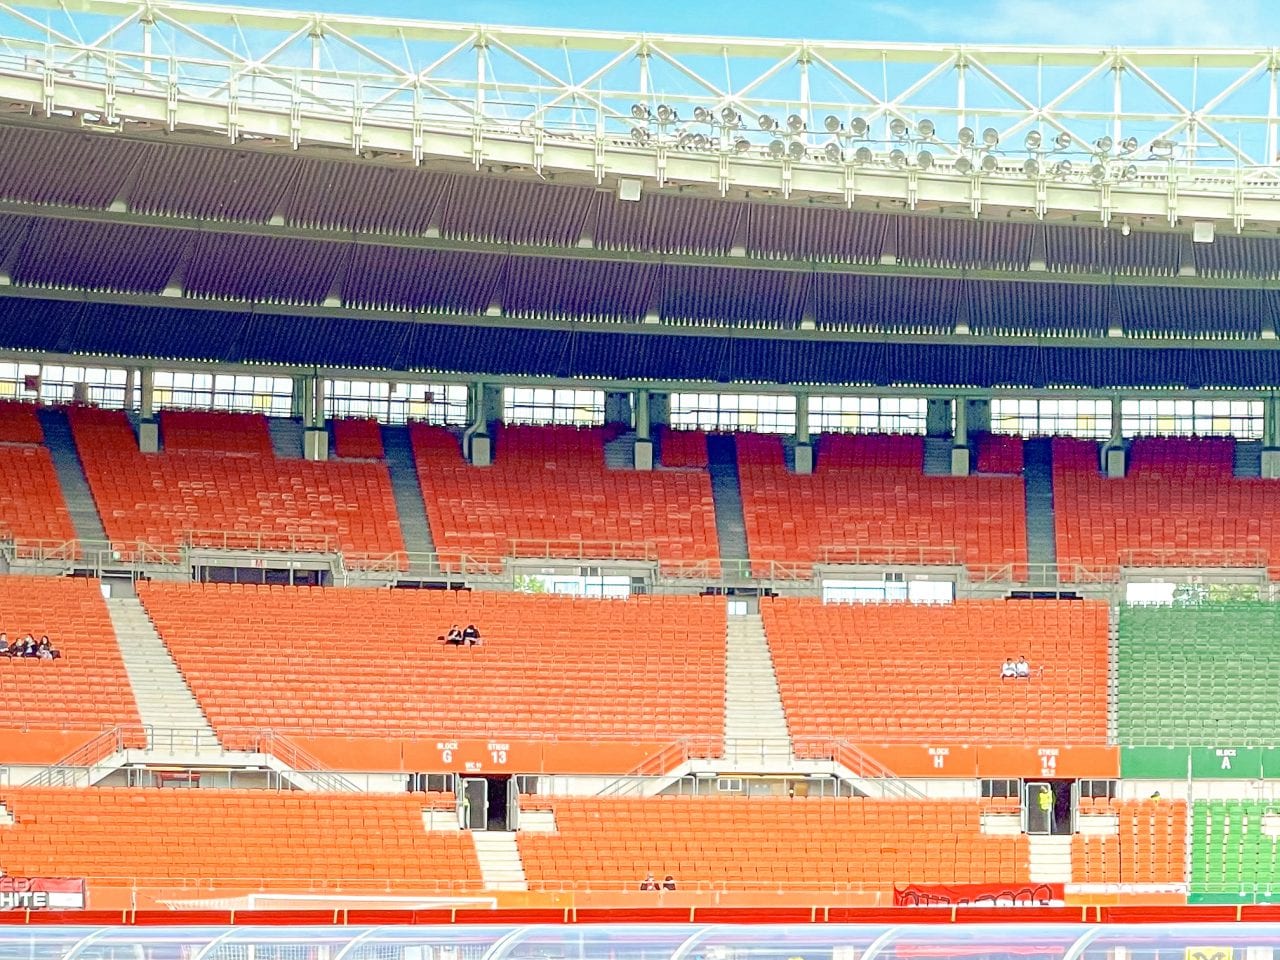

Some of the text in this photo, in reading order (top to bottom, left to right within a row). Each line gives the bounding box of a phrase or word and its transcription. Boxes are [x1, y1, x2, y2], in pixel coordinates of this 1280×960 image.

[442, 750, 453, 764] G
[491, 750, 507, 764] 13
[934, 755, 944, 768] H
[1041, 756, 1056, 769] 14
[1221, 756, 1232, 770] A
